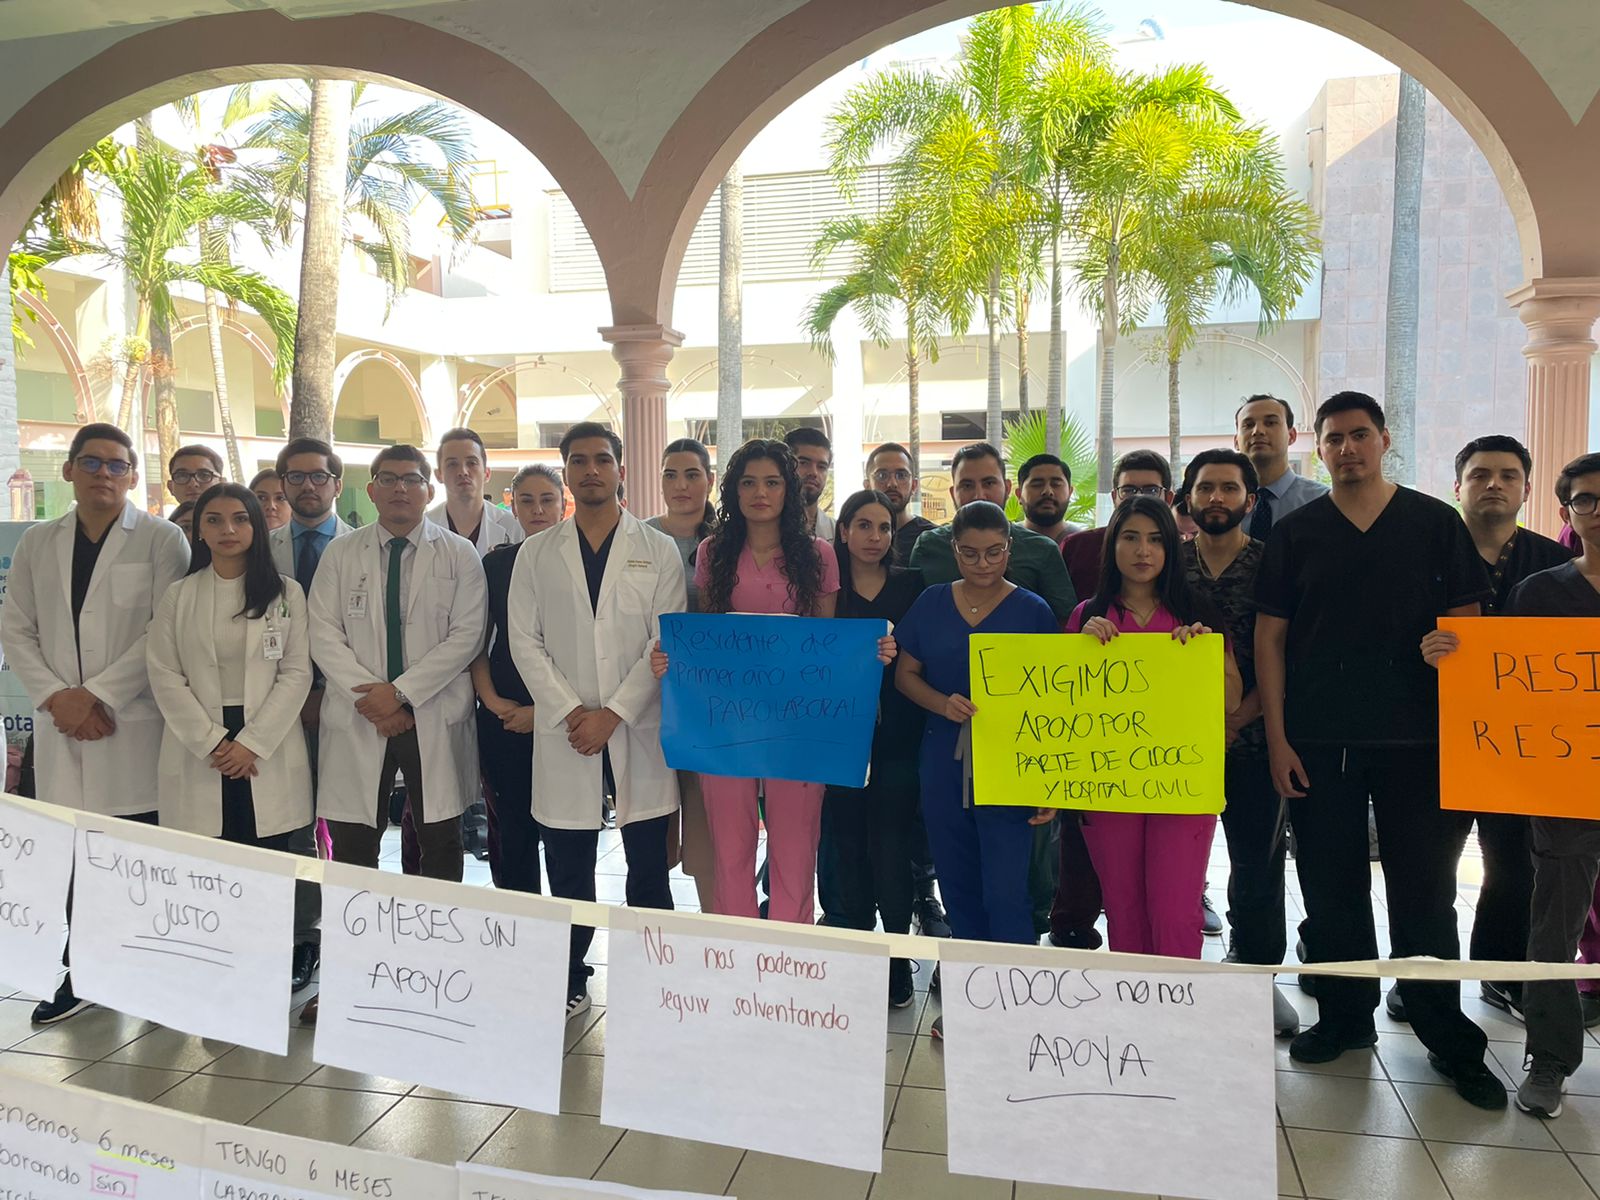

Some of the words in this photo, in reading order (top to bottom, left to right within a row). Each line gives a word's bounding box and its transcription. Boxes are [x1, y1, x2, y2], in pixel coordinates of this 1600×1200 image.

[670, 620, 791, 657] Residentes
[801, 632, 841, 656] de
[675, 661, 734, 688] Primer
[743, 664, 785, 687] año
[800, 664, 832, 686] en
[979, 647, 1149, 705] EXIGIMOS
[1493, 651, 1600, 692] RESI
[1014, 710, 1093, 743] APOYO
[1099, 710, 1152, 737] POR
[1016, 751, 1082, 777] PARTE
[1091, 750, 1122, 773] DE
[1129, 744, 1204, 771] CIDOCS
[1044, 780, 1060, 800] Y
[1064, 779, 1138, 804] HOSPITAL
[1143, 779, 1203, 799] CIVIL
[86, 829, 178, 906] Exigimos
[187, 870, 243, 899] trato
[153, 899, 220, 936] JUSTO
[343, 890, 371, 936] 6
[377, 896, 464, 944] MESES
[480, 916, 517, 948] SIN
[644, 926, 675, 966] No
[704, 945, 735, 970] nos
[756, 951, 828, 983] podemos
[368, 961, 473, 1009] APOYO
[659, 987, 710, 1023] seguir
[965, 965, 1102, 1011] CIDOCS
[1116, 979, 1150, 1004] no
[1158, 981, 1194, 1006] nos
[1029, 1033, 1154, 1086] APOYA
[98, 1128, 112, 1152] 6
[120, 1142, 176, 1171] meses
[216, 1141, 287, 1176] TENGO
[309, 1159, 318, 1181] 6
[335, 1168, 393, 1198] MESES
[96, 1174, 128, 1197] sin
